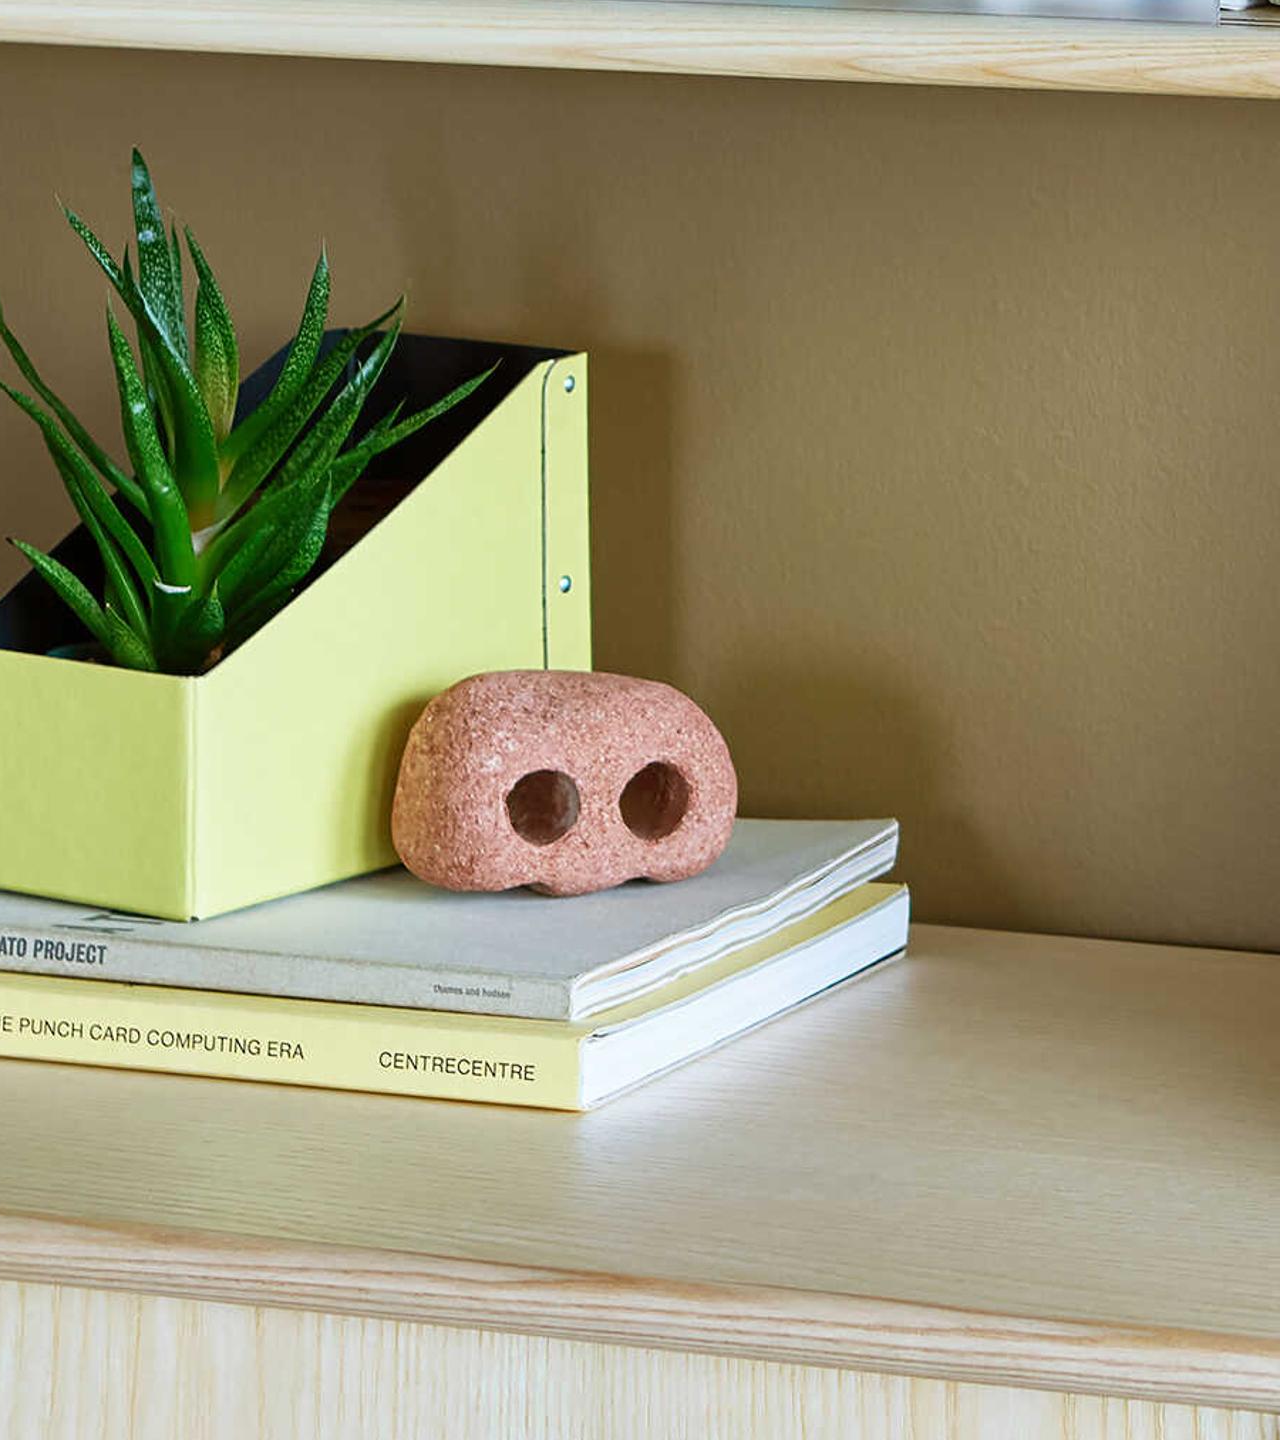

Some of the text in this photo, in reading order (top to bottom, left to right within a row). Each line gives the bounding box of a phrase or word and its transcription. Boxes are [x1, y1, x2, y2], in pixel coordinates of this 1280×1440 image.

[33, 938, 108, 965] PROJECT
[19, 1017, 84, 1039] PUNCH
[89, 1023, 141, 1045] CARD
[146, 1029, 261, 1057] COMPUTING
[267, 1040, 305, 1061] ERA
[378, 1051, 536, 1082] CENTRECENTRE
